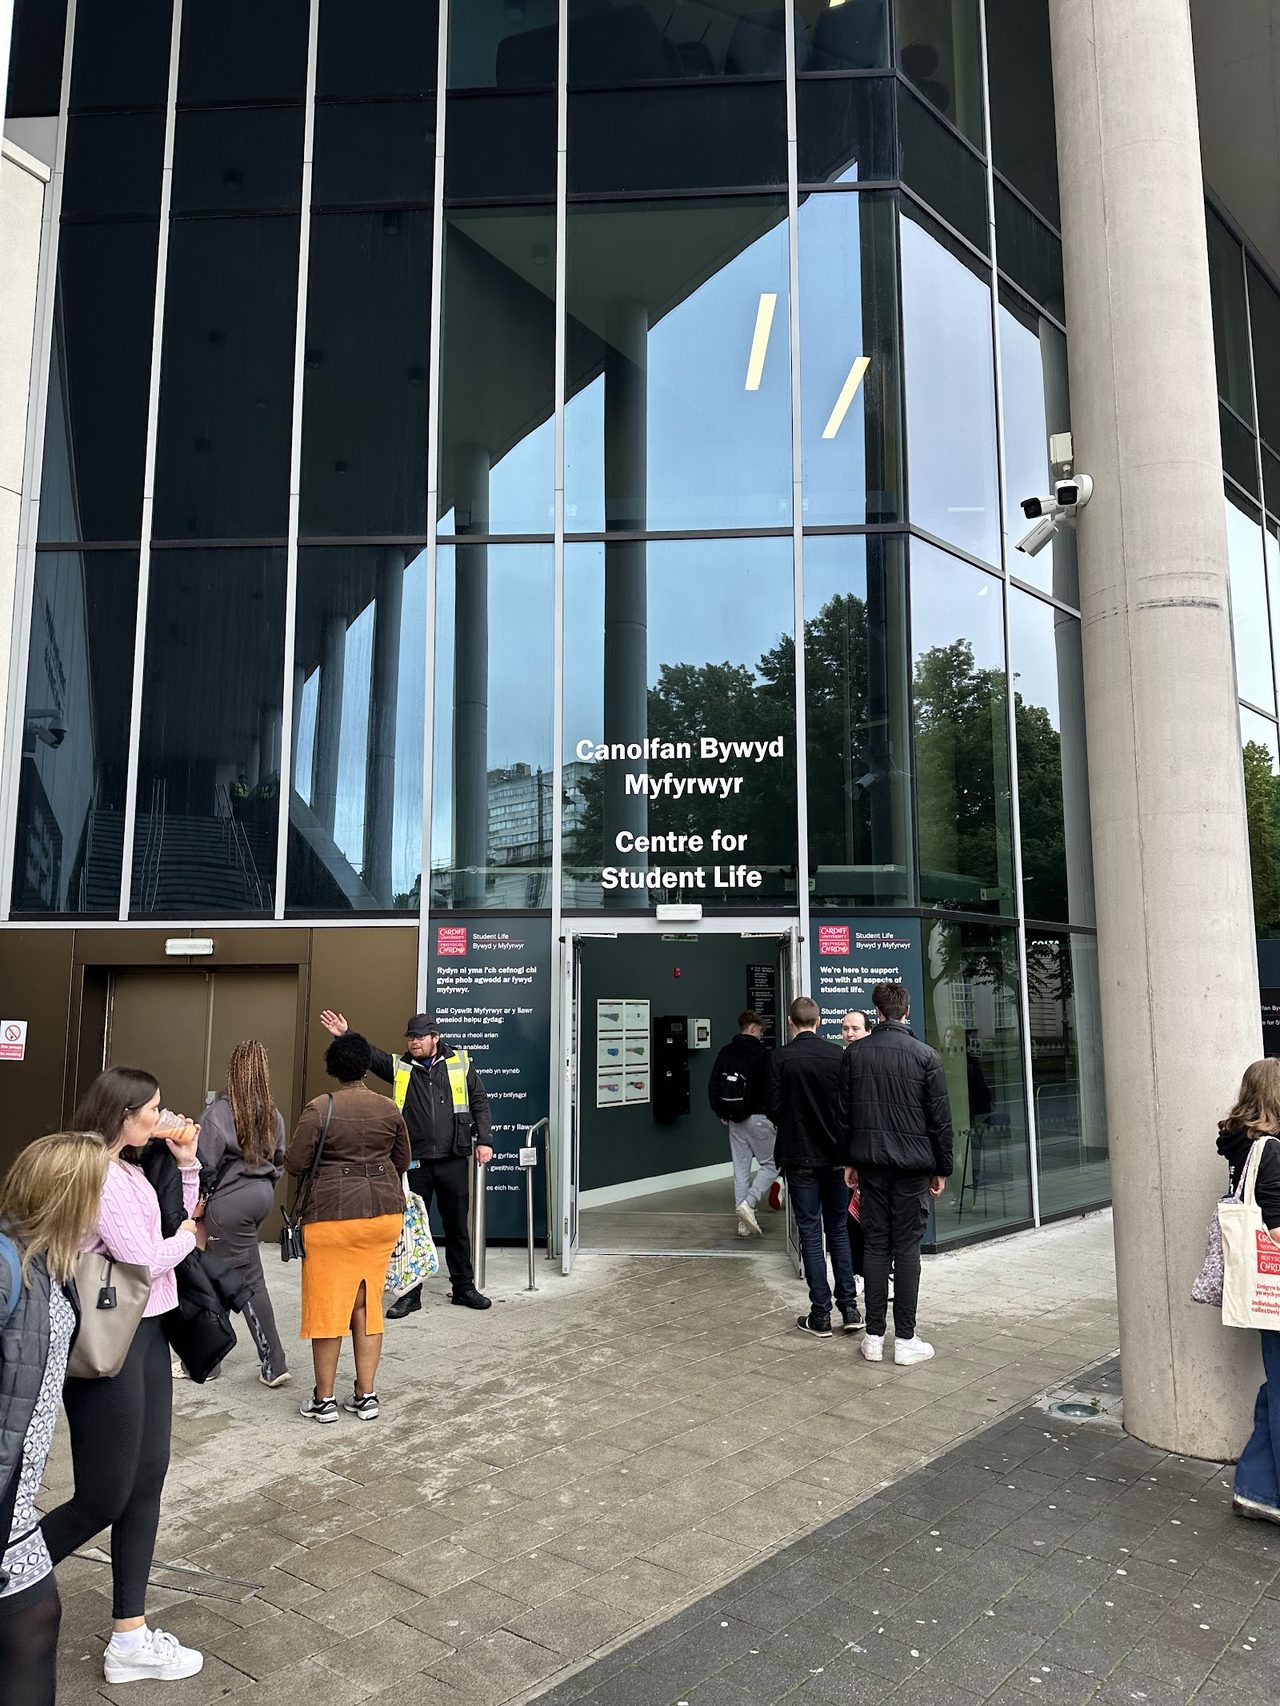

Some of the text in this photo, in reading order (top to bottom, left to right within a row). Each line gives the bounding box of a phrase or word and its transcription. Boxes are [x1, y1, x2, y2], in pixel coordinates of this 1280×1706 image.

[576, 736, 784, 763] Canolfan Bywyd
[624, 772, 744, 799] Myfyrwyr
[615, 829, 748, 853] Centre for
[601, 865, 762, 889] Student Life
[437, 967, 458, 975] Rydyn
